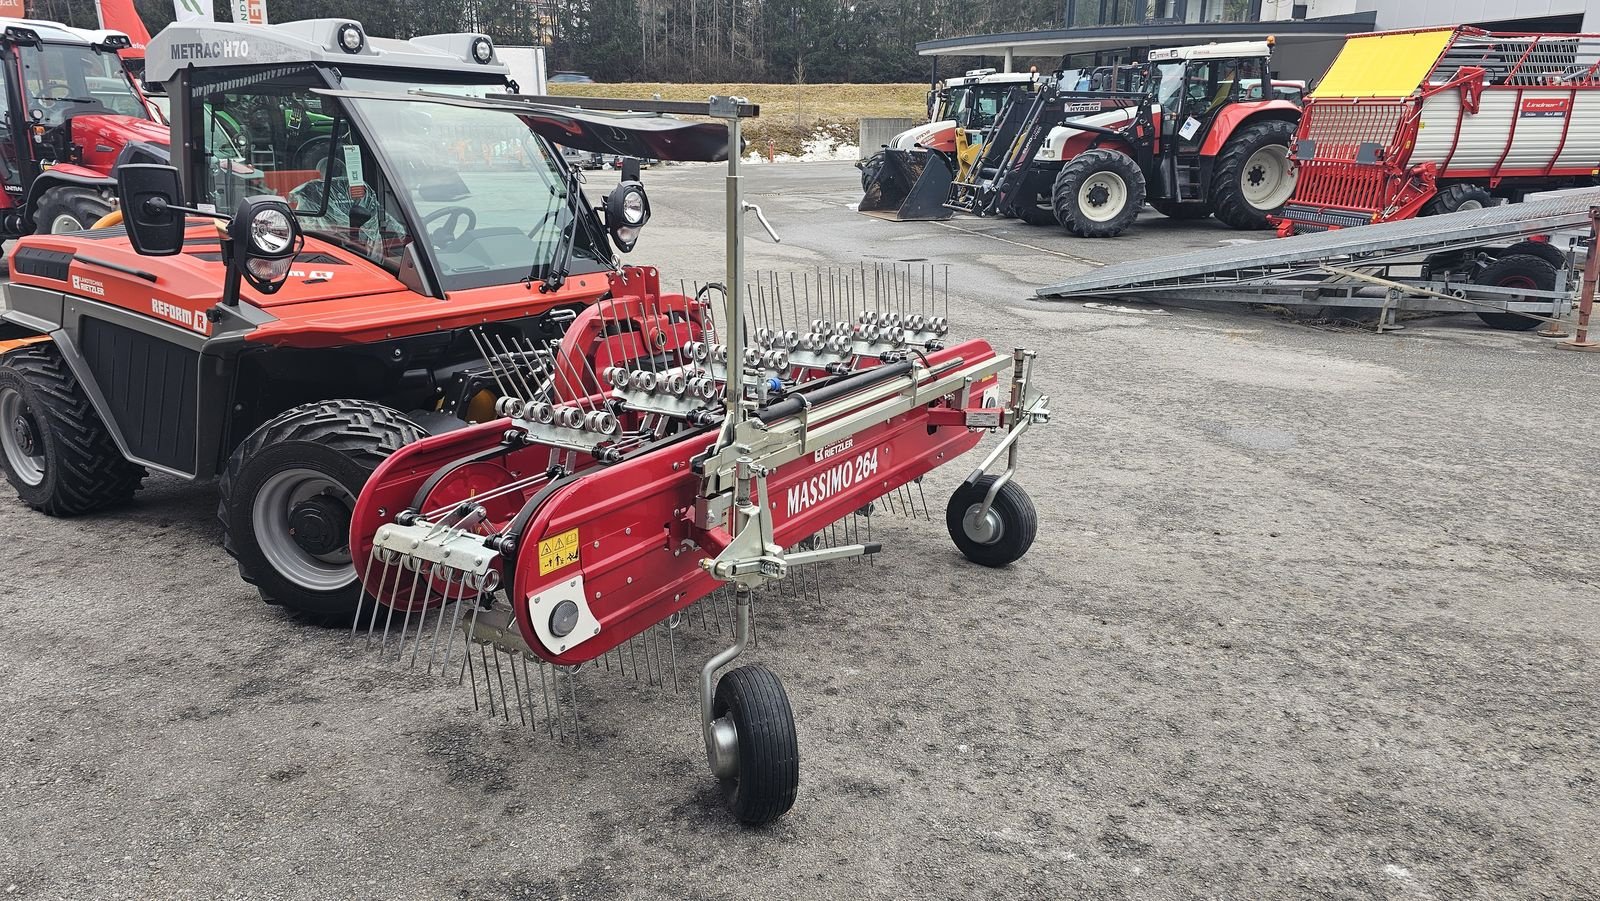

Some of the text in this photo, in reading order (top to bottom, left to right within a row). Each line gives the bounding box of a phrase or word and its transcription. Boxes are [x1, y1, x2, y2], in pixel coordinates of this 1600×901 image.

[171, 40, 249, 59] METRAC H70
[151, 298, 192, 325] REFORM
[824, 438, 854, 459] RIETZLER
[787, 448, 878, 518] MASSIMO 264
